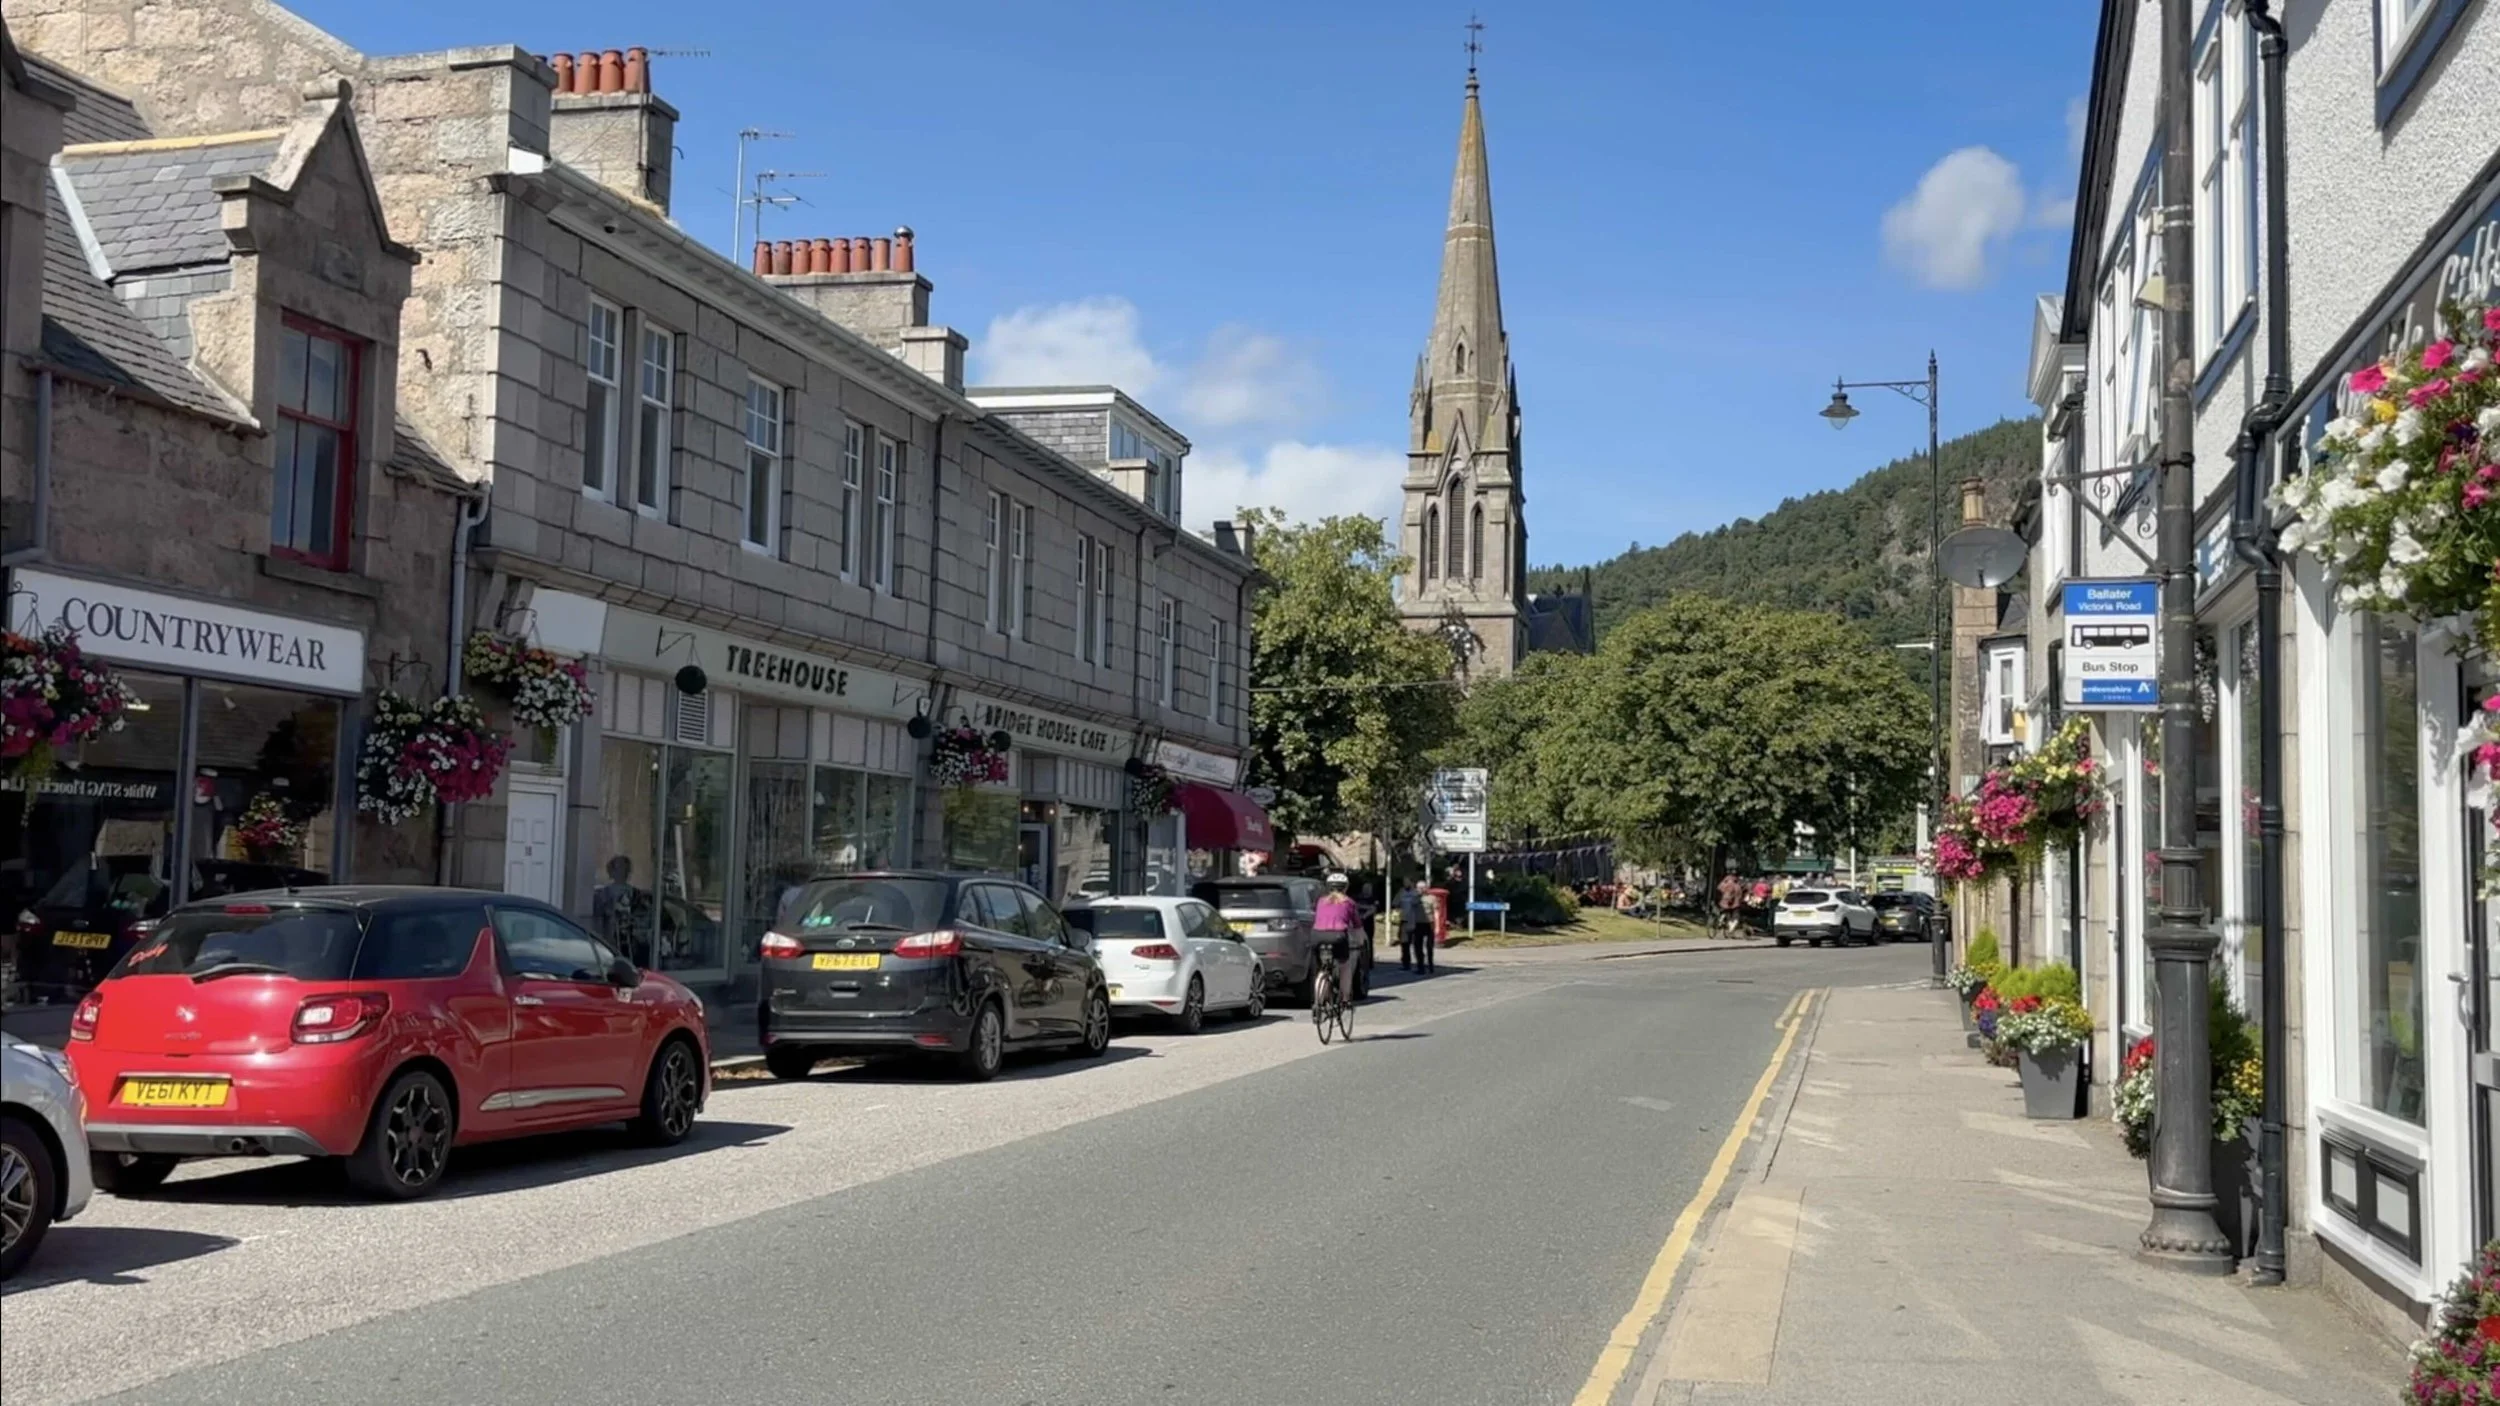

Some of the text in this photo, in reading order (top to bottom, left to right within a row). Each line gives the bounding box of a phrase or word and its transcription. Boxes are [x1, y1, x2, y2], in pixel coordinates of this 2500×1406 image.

[2087, 588, 2133, 600] Ballater
[2078, 602, 2142, 611] Victoria Road
[62, 597, 326, 671] COUNTRYWEAR
[727, 645, 849, 697] TREEHOUSE
[2082, 662, 2138, 674] Bus Stop
[985, 705, 1109, 752] BRIDGE HOUSE CAFE
[136, 1080, 217, 1101] VE61 KYT
